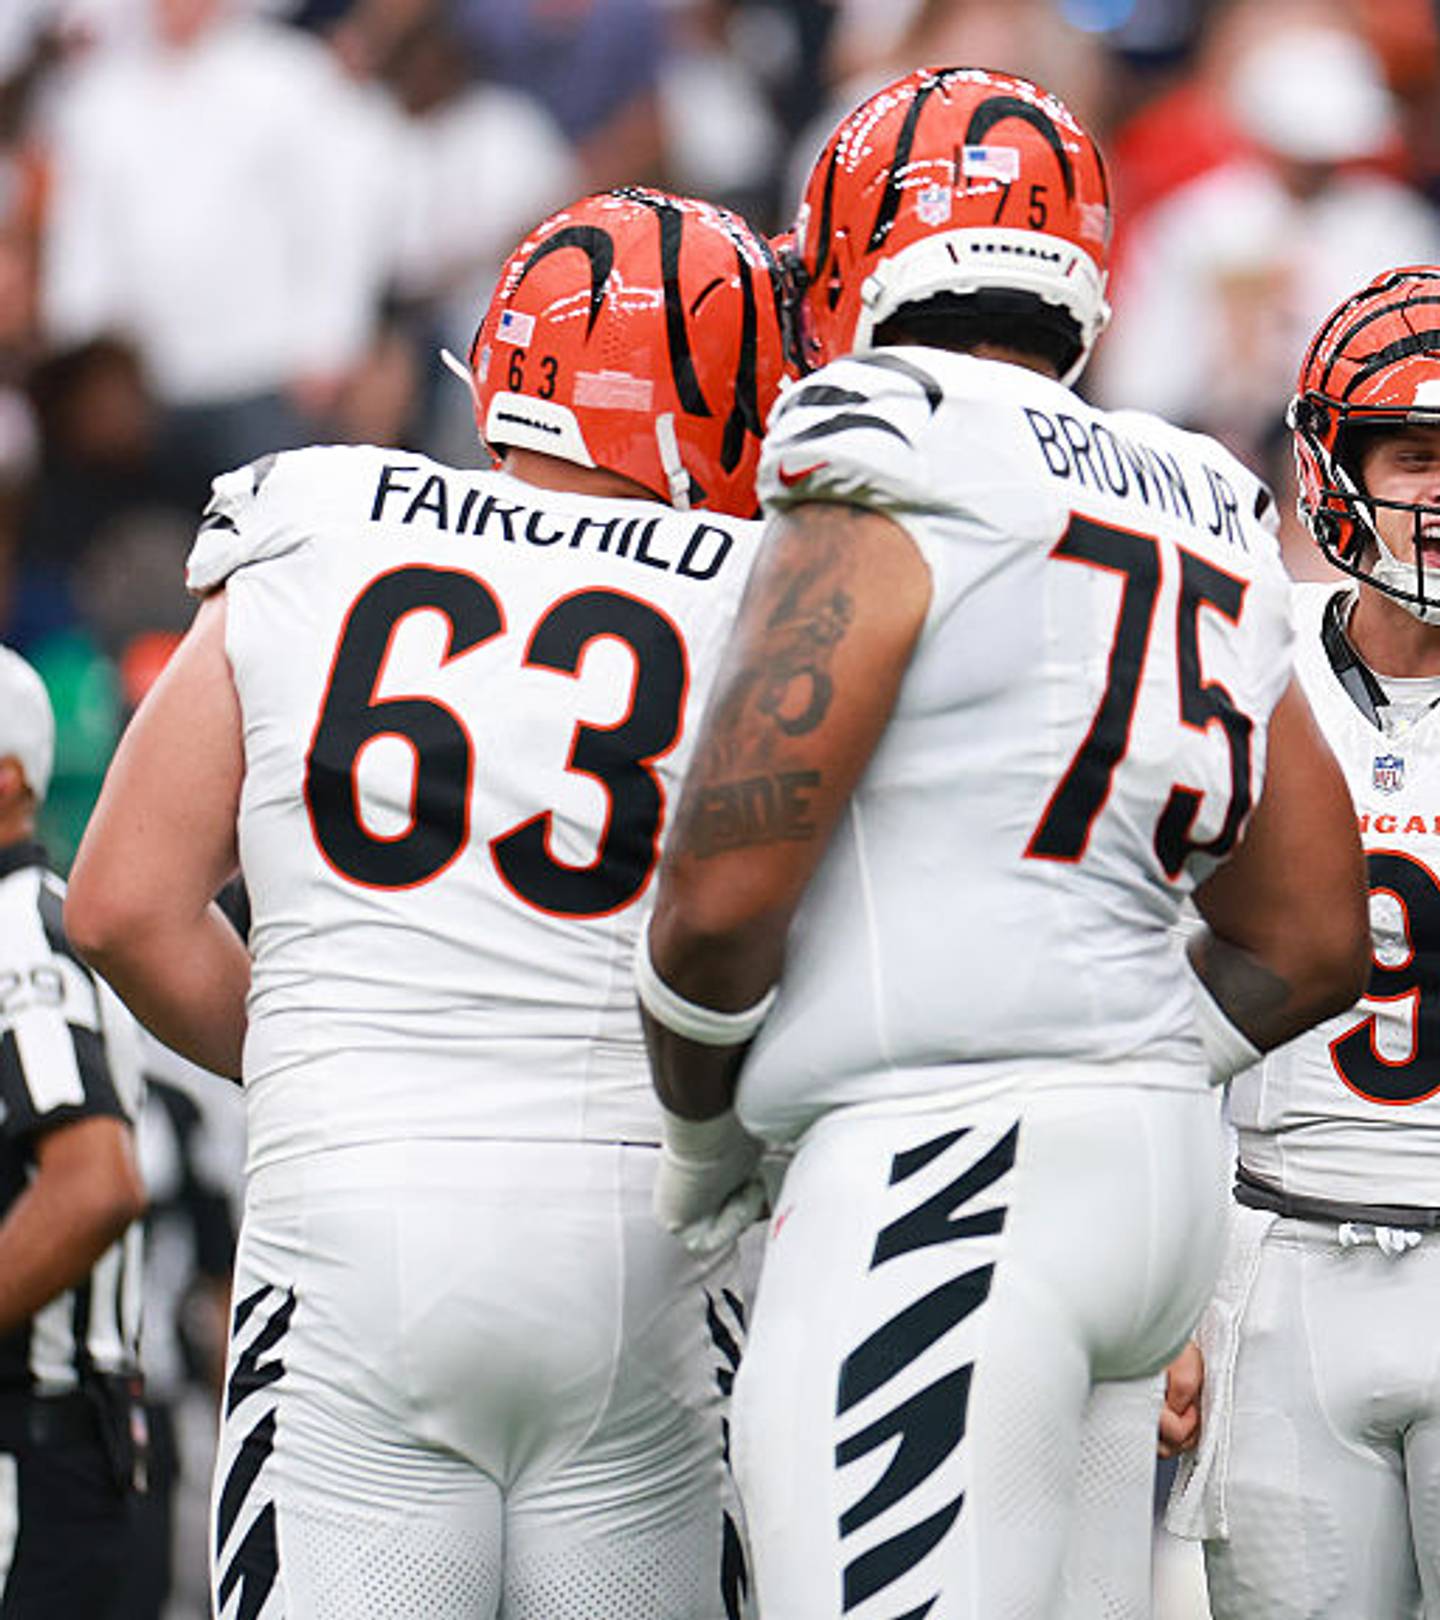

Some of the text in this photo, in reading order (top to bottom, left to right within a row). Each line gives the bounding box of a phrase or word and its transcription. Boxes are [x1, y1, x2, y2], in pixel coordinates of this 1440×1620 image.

[993, 178, 1047, 230] 75
[507, 348, 558, 400] 63
[370, 464, 734, 581] FAIRCHILD
[1023, 407, 1249, 554] BROWN JR
[302, 562, 691, 921] 63
[1022, 509, 1254, 882] 75
